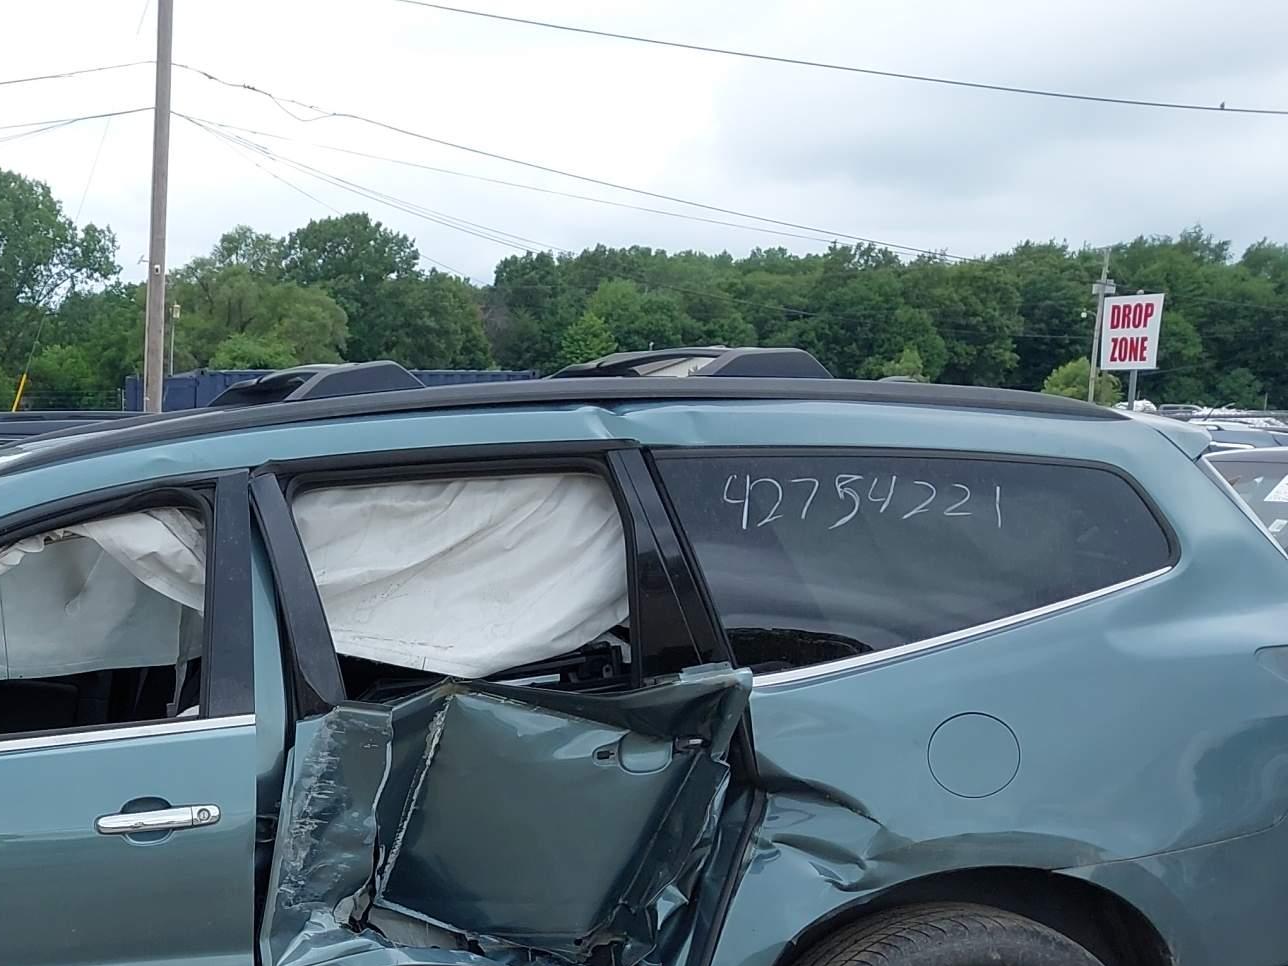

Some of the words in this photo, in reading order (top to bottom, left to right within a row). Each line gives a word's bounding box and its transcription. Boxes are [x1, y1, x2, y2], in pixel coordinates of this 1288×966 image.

[1110, 302, 1155, 330] DROP
[1109, 336, 1149, 362] ZONE
[722, 474, 1003, 530] 42754221
